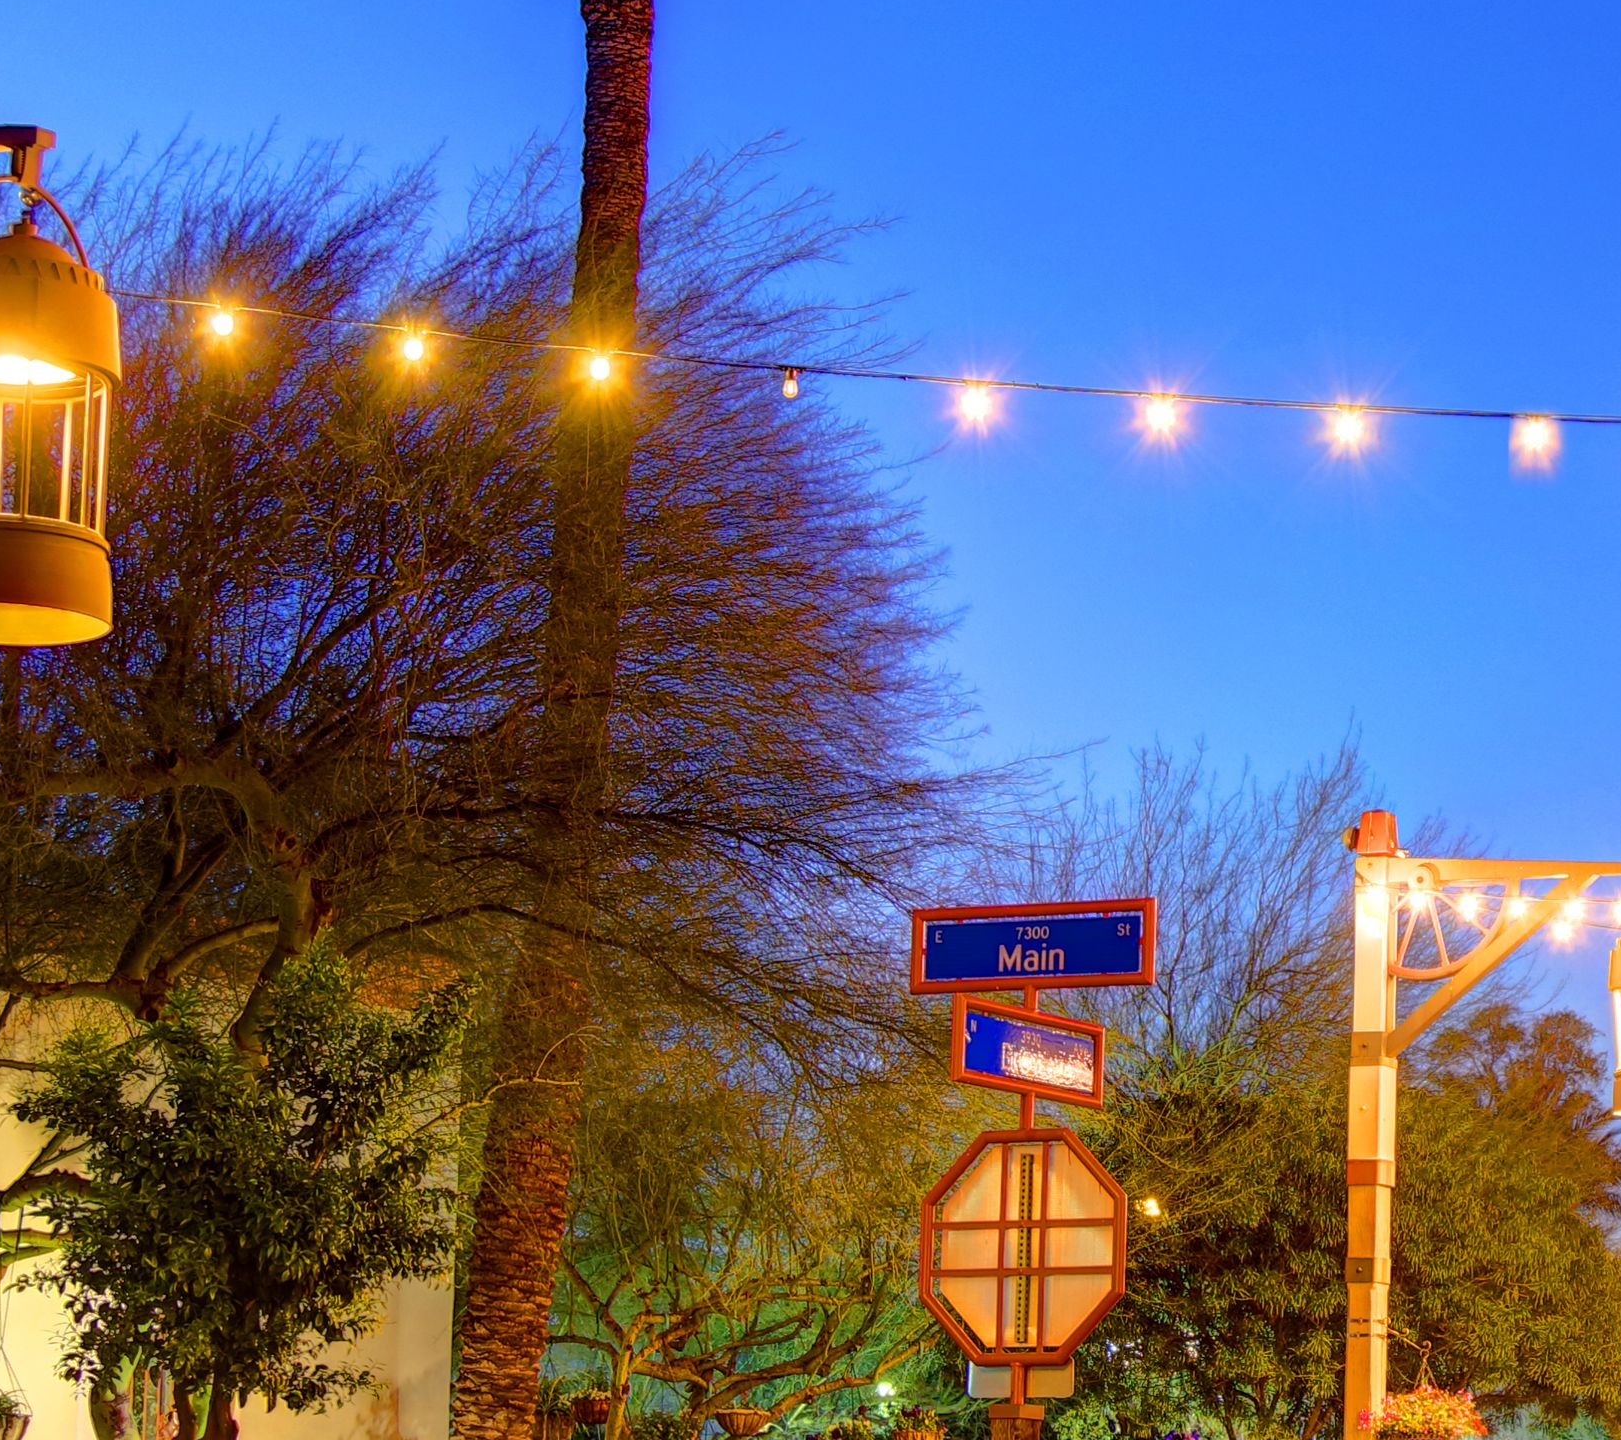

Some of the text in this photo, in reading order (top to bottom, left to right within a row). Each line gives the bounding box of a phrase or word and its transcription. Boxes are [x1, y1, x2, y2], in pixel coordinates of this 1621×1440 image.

[1016, 926, 1050, 940] 7300
[935, 923, 1131, 973] E Main St
[970, 1019, 978, 1033] N
